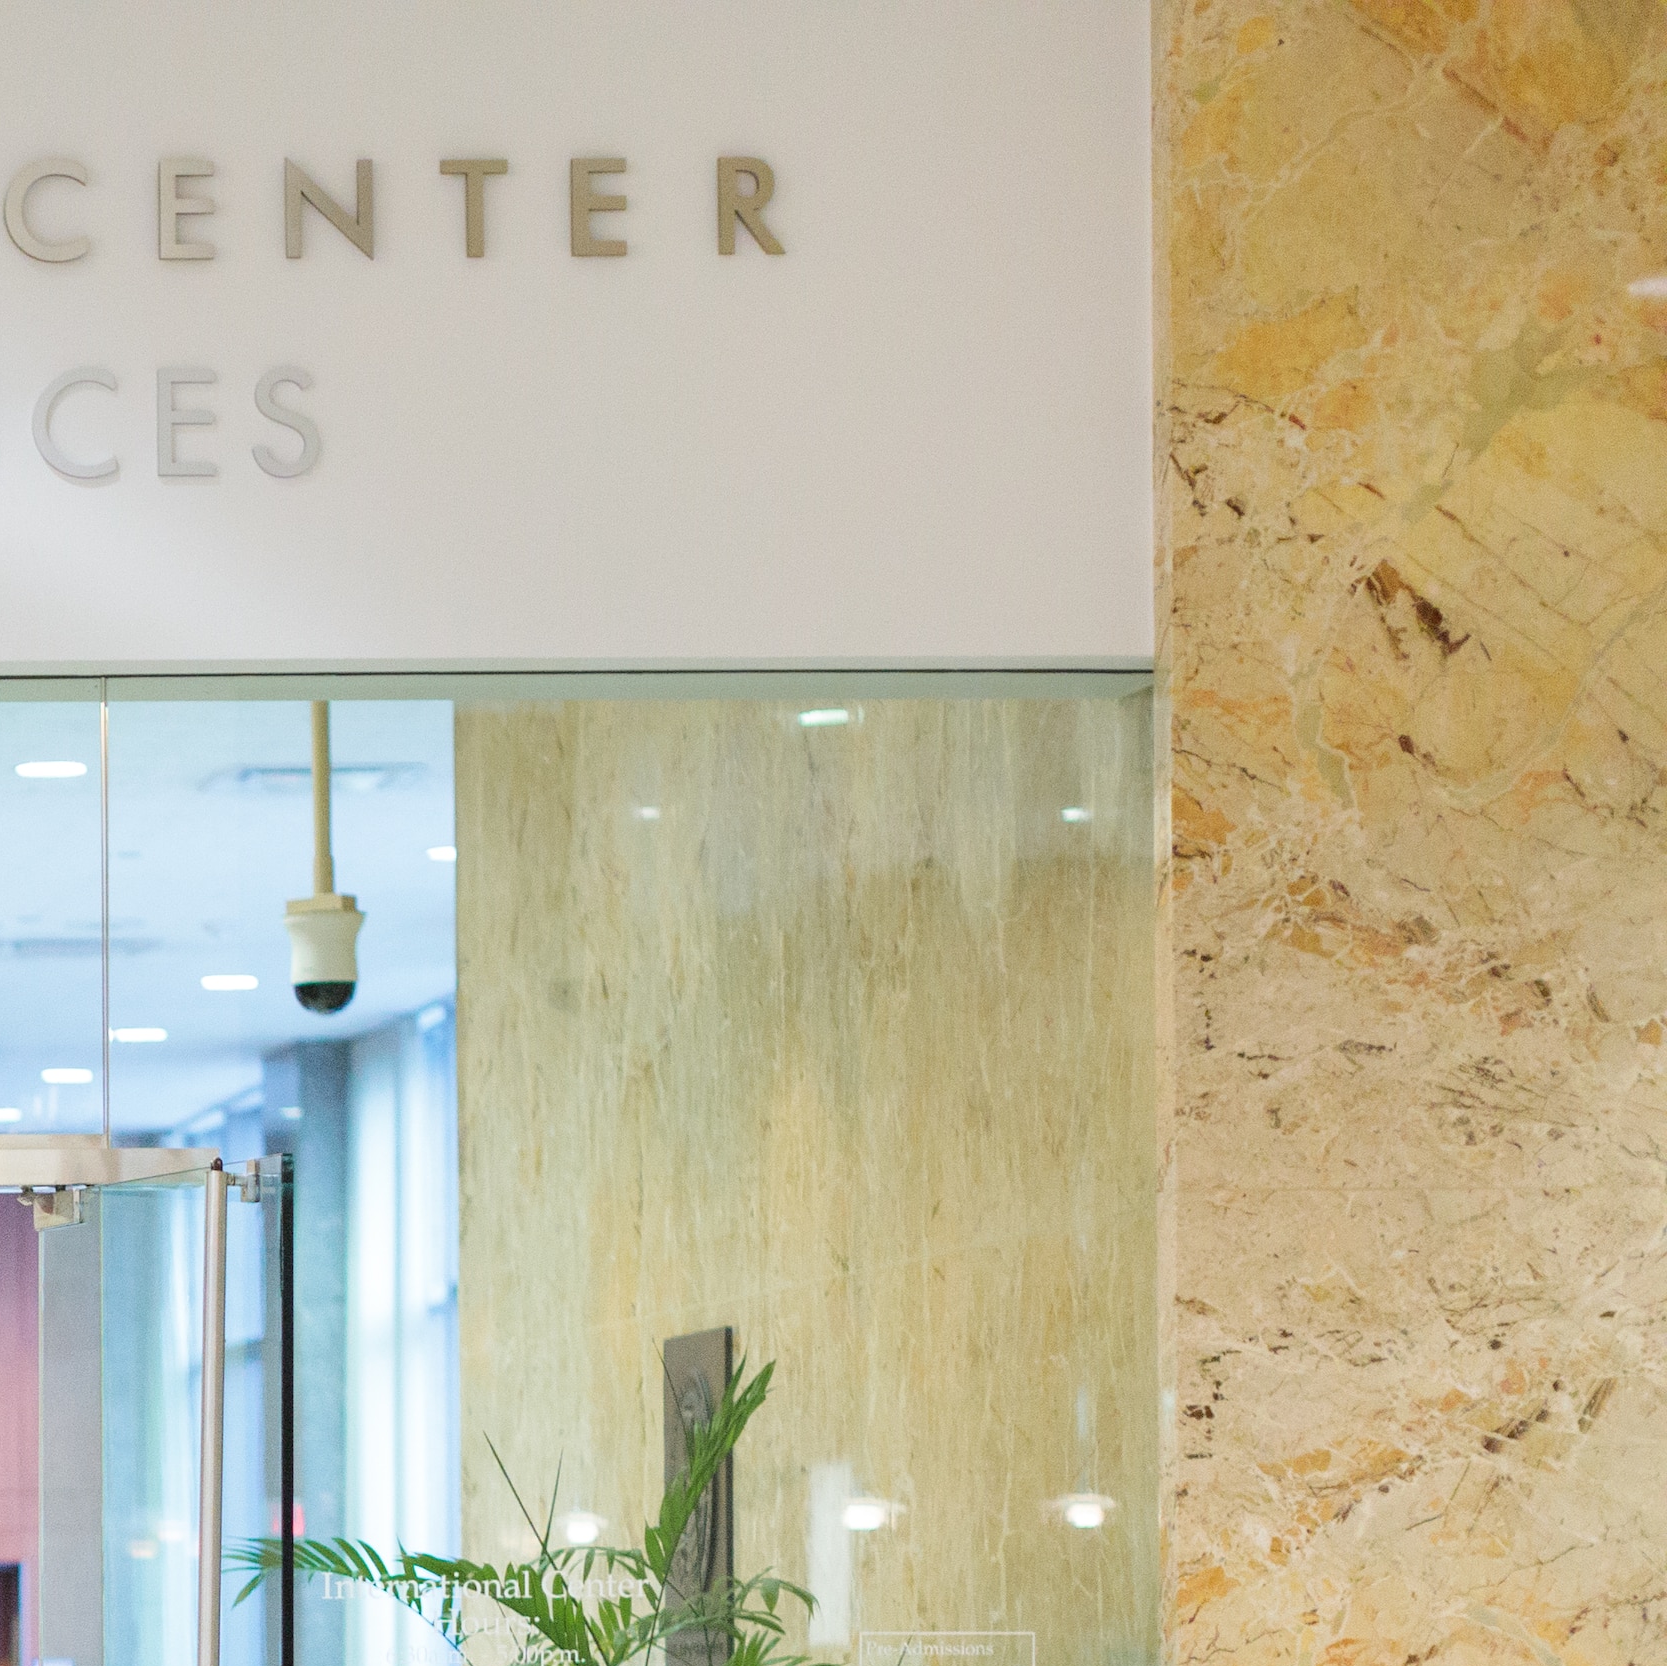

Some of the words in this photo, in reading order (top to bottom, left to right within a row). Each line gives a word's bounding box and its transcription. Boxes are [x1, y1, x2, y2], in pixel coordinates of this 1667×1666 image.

[2, 156, 787, 263] CENTER
[321, 1570, 534, 1600] International
[542, 1570, 651, 1600] Center
[434, 1608, 541, 1637] Hours:
[866, 1641, 994, 1656] Pre-Admissions
